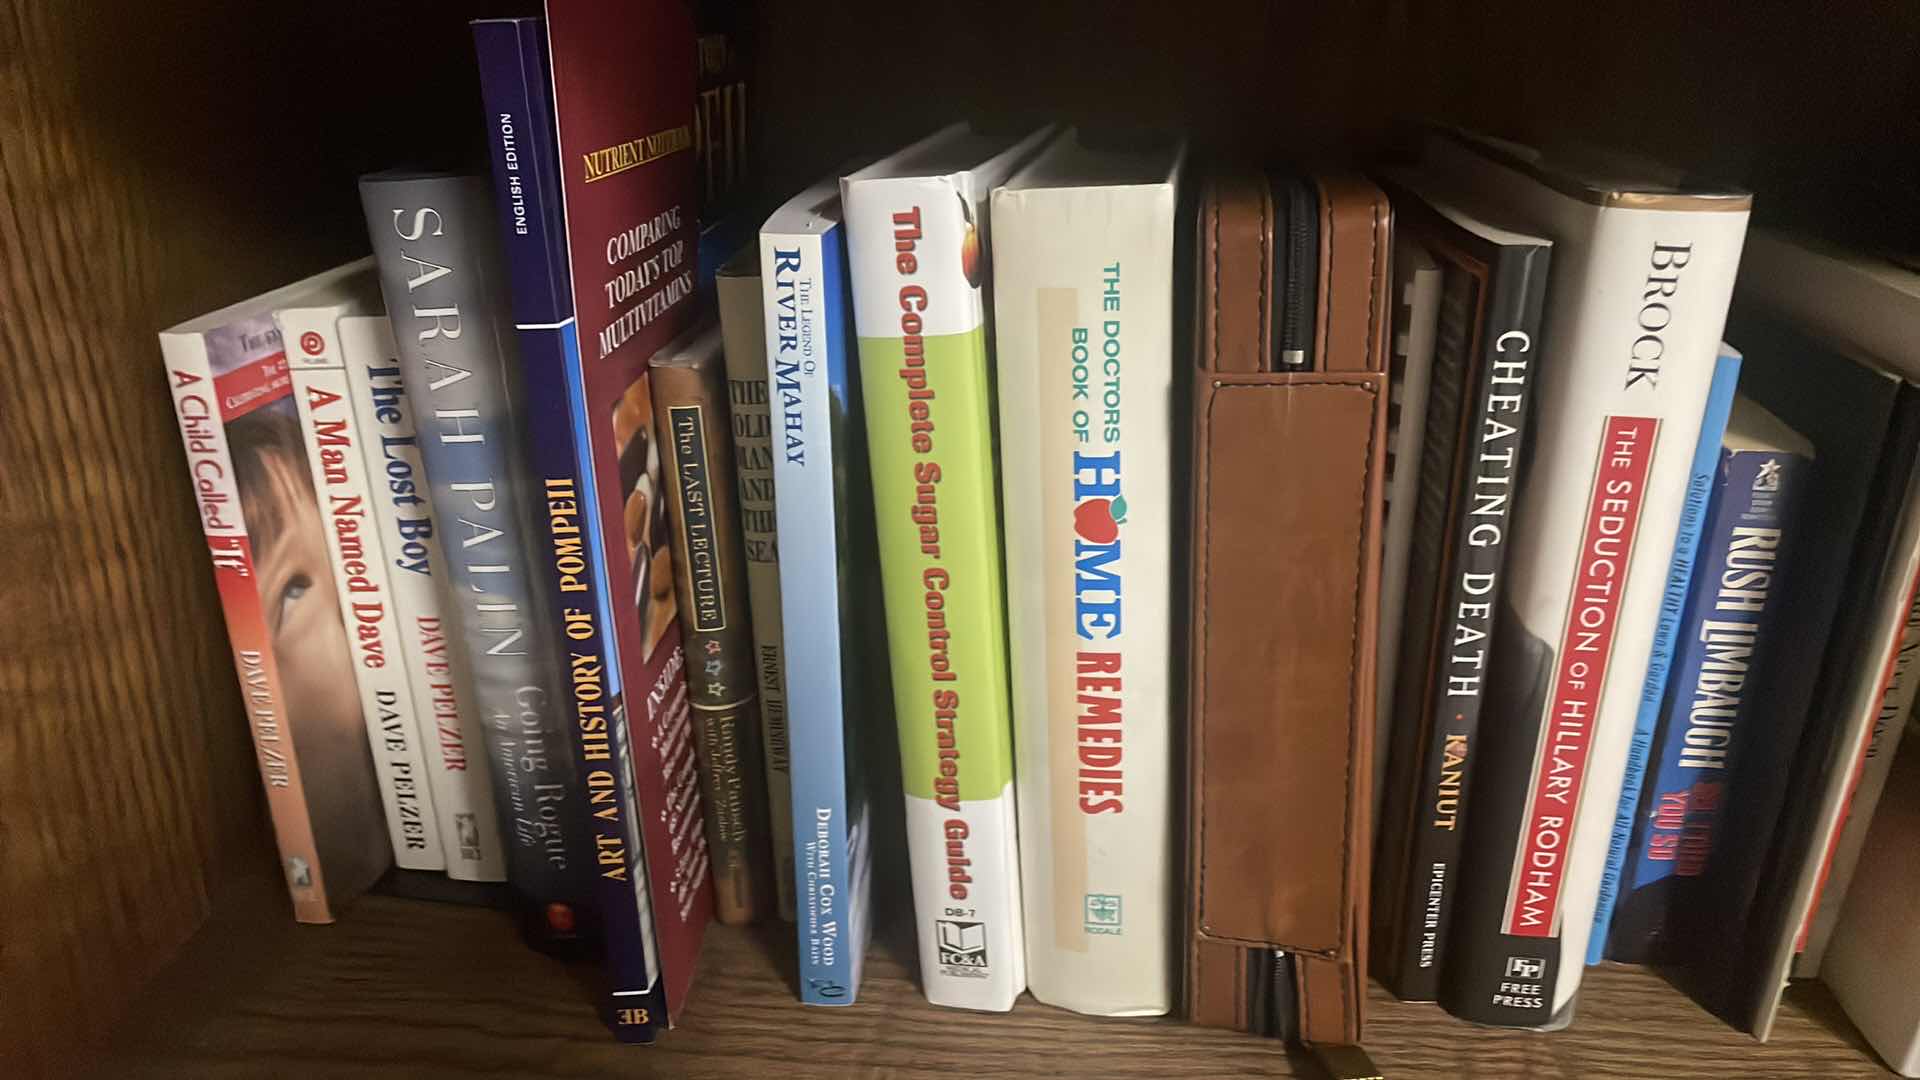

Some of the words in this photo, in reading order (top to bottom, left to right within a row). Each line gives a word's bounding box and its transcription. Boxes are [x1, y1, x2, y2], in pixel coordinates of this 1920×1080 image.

[499, 113, 519, 171] EDITION
[583, 137, 647, 180] NUTRIENT
[509, 176, 528, 235] ENGLISH
[606, 205, 681, 265] COMPARING
[892, 205, 922, 275] The
[661, 240, 684, 273] TOP
[1103, 261, 1121, 311] THE
[599, 270, 693, 360] MULTIVITAMINS
[774, 247, 802, 353] RIVER
[1623, 240, 1694, 392] BROCK
[172, 369, 203, 389] A
[306, 386, 343, 411] A
[898, 285, 936, 454] Complete
[1071, 327, 1089, 401] BOOK
[1103, 320, 1121, 443] DOCTORS
[179, 397, 216, 454] Child
[393, 207, 485, 444] SARAH
[450, 478, 528, 656] PALIN
[775, 358, 804, 467] MAHAY
[1072, 409, 1090, 444] OF
[1467, 329, 1531, 549] CHEATING
[1609, 426, 1637, 469] THE
[313, 419, 352, 485] Man
[380, 435, 426, 507] Lost
[194, 459, 235, 531] Called
[683, 462, 705, 518] LAST
[911, 461, 942, 560] Sugar
[211, 538, 250, 578] "It"
[330, 494, 381, 594] Named
[396, 517, 433, 577] Boy
[545, 478, 588, 593] POMPEII
[1574, 480, 1633, 653] SEDUCTION
[1714, 525, 1782, 612] RUSH
[690, 523, 717, 622] LECTURE
[351, 600, 386, 669] Dave
[417, 616, 450, 675] DAVE
[563, 607, 595, 640] OF
[923, 567, 957, 682] Control
[1447, 571, 1495, 698] DEATH
[240, 649, 271, 705] DAVE
[571, 652, 613, 762] HISTORY
[1568, 661, 1591, 691] OF
[1678, 619, 1760, 769] LIMBAUGH
[253, 708, 288, 789] PELZER
[375, 690, 408, 753] DAVE
[431, 683, 467, 772] PELZER
[515, 685, 556, 773] Going
[933, 688, 961, 813] Strategy
[1075, 651, 1124, 815] REMEDIES
[1540, 699, 1589, 806] HILLARY
[391, 761, 427, 850] PELZER
[585, 770, 621, 822] AND
[1433, 733, 1468, 832] KANIUT
[534, 784, 566, 870] Rogue
[596, 834, 628, 882] ART
[816, 807, 832, 879] DEBORAH
[943, 818, 973, 901] Guide
[819, 883, 836, 916] COX
[1424, 863, 1447, 928] EPICENTER
[1519, 815, 1564, 928] RODHAM
[822, 920, 838, 967] WOOD
[941, 952, 986, 967] FC&A
[1419, 931, 1436, 969] PRESS
[1491, 993, 1545, 1010] PRESS
[1499, 981, 1544, 995] FREE
